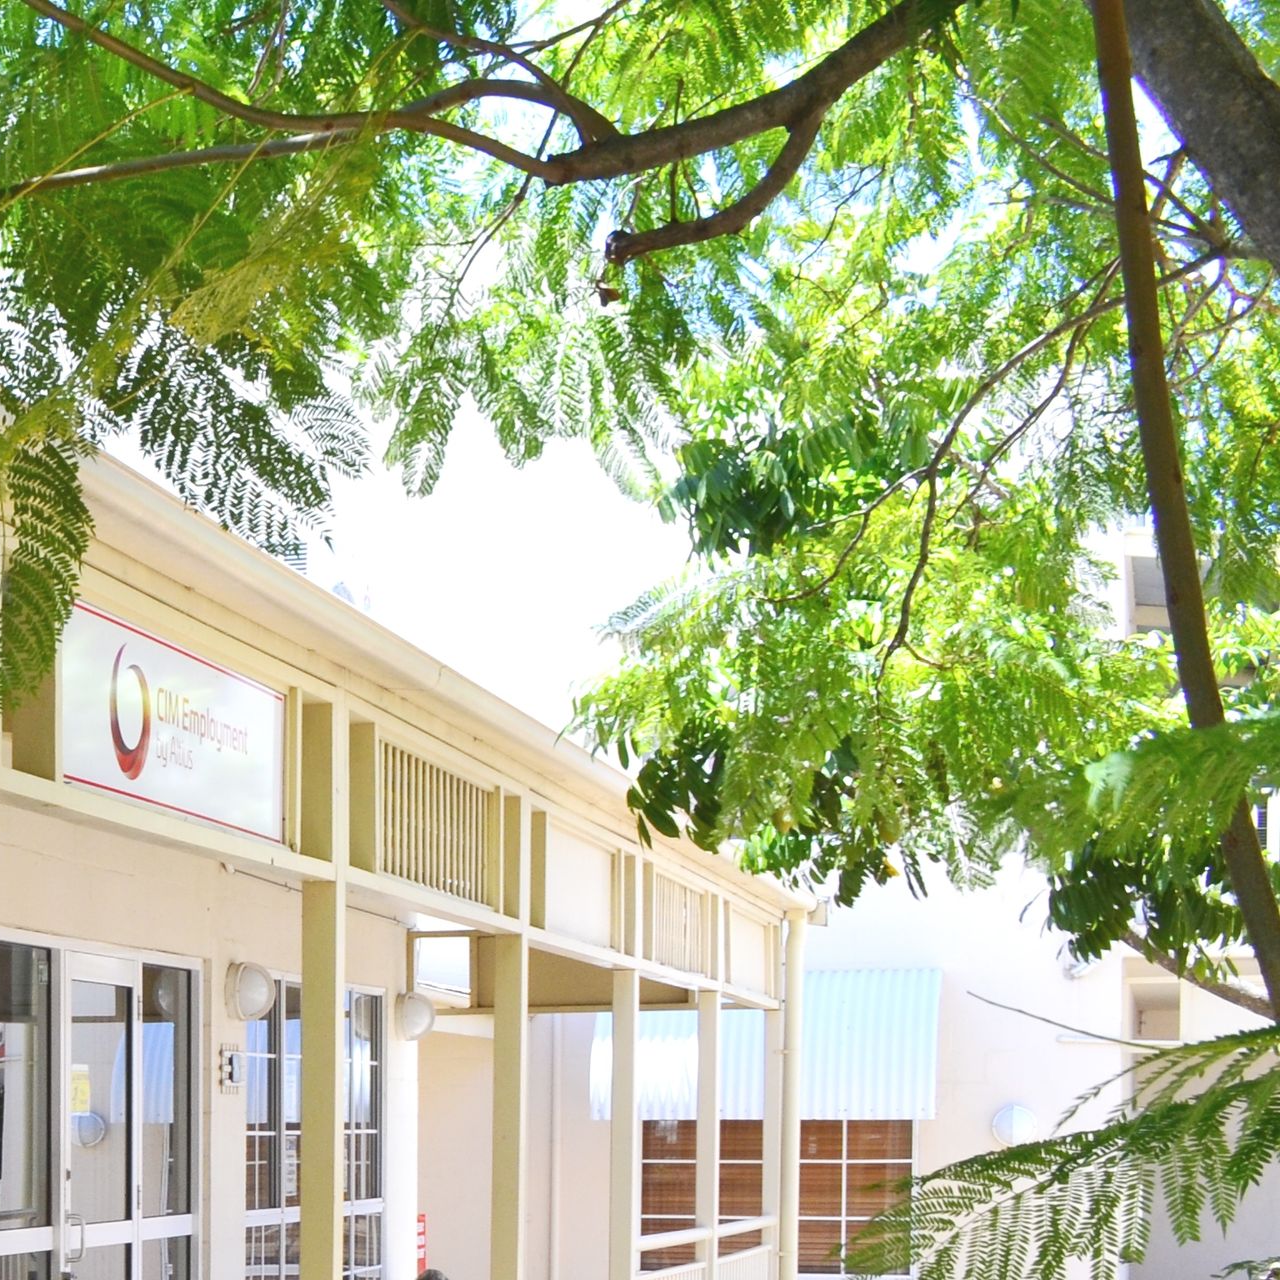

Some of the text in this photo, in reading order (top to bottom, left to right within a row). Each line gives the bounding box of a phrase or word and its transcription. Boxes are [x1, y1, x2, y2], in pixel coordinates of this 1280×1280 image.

[156, 688, 249, 755] CIM Employment
[156, 731, 193, 770] by Altius
